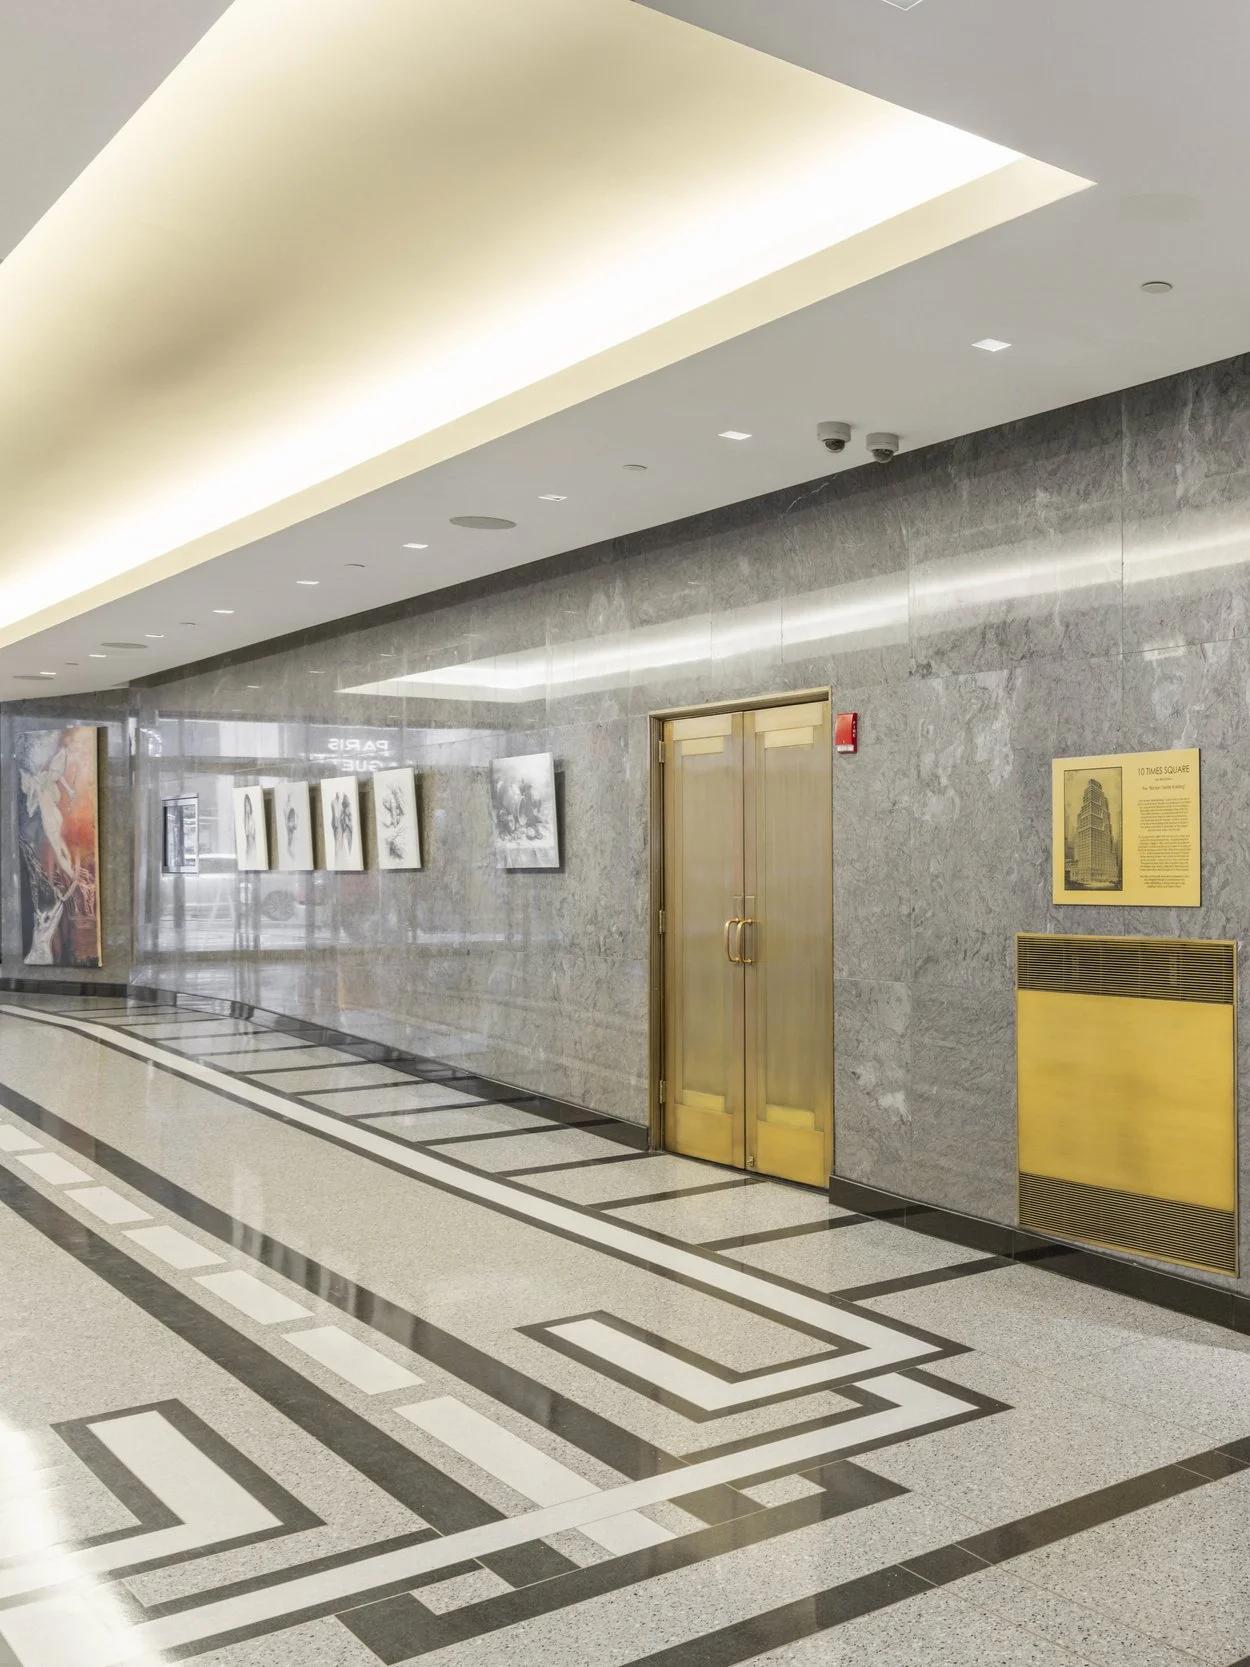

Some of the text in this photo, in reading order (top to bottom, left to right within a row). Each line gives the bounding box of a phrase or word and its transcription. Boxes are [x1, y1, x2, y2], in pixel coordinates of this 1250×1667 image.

[1137, 764, 1190, 776] 10 TIMES SQUARE
